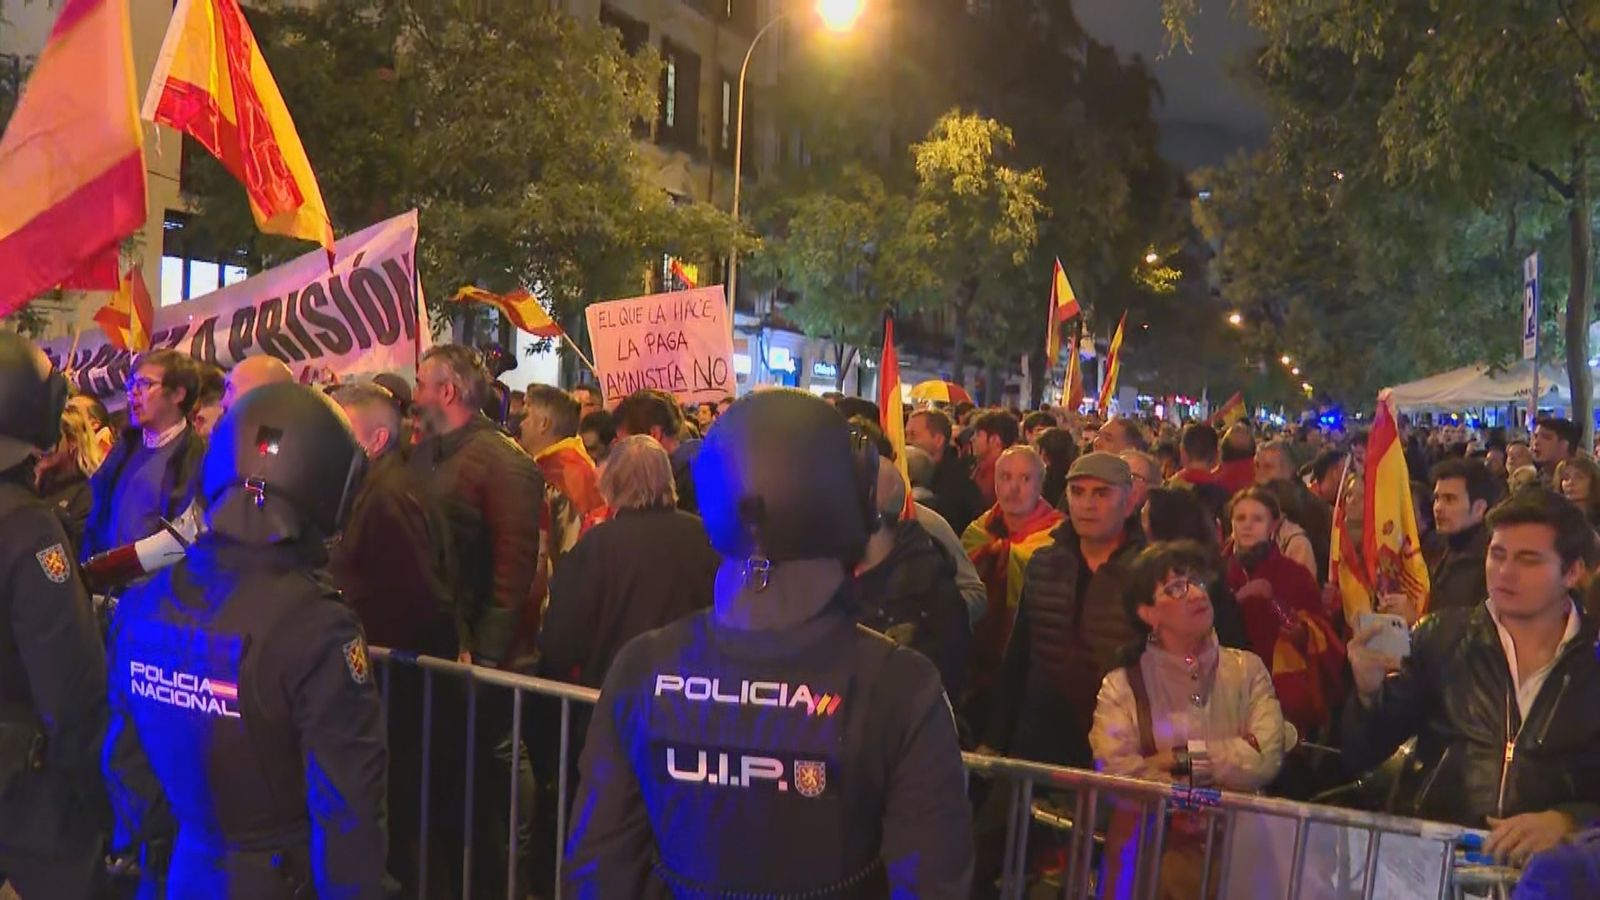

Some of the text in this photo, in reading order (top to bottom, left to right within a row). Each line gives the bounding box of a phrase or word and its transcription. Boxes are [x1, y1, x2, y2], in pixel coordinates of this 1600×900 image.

[599, 299, 717, 329] EL QUE LA HACE,
[618, 330, 688, 361] LA PAGA
[693, 355, 728, 388] NO
[130, 661, 214, 695] POLICIA
[654, 674, 815, 712] POLICIA
[131, 679, 241, 718] NACIONAL
[667, 748, 789, 791] U.I.P.
